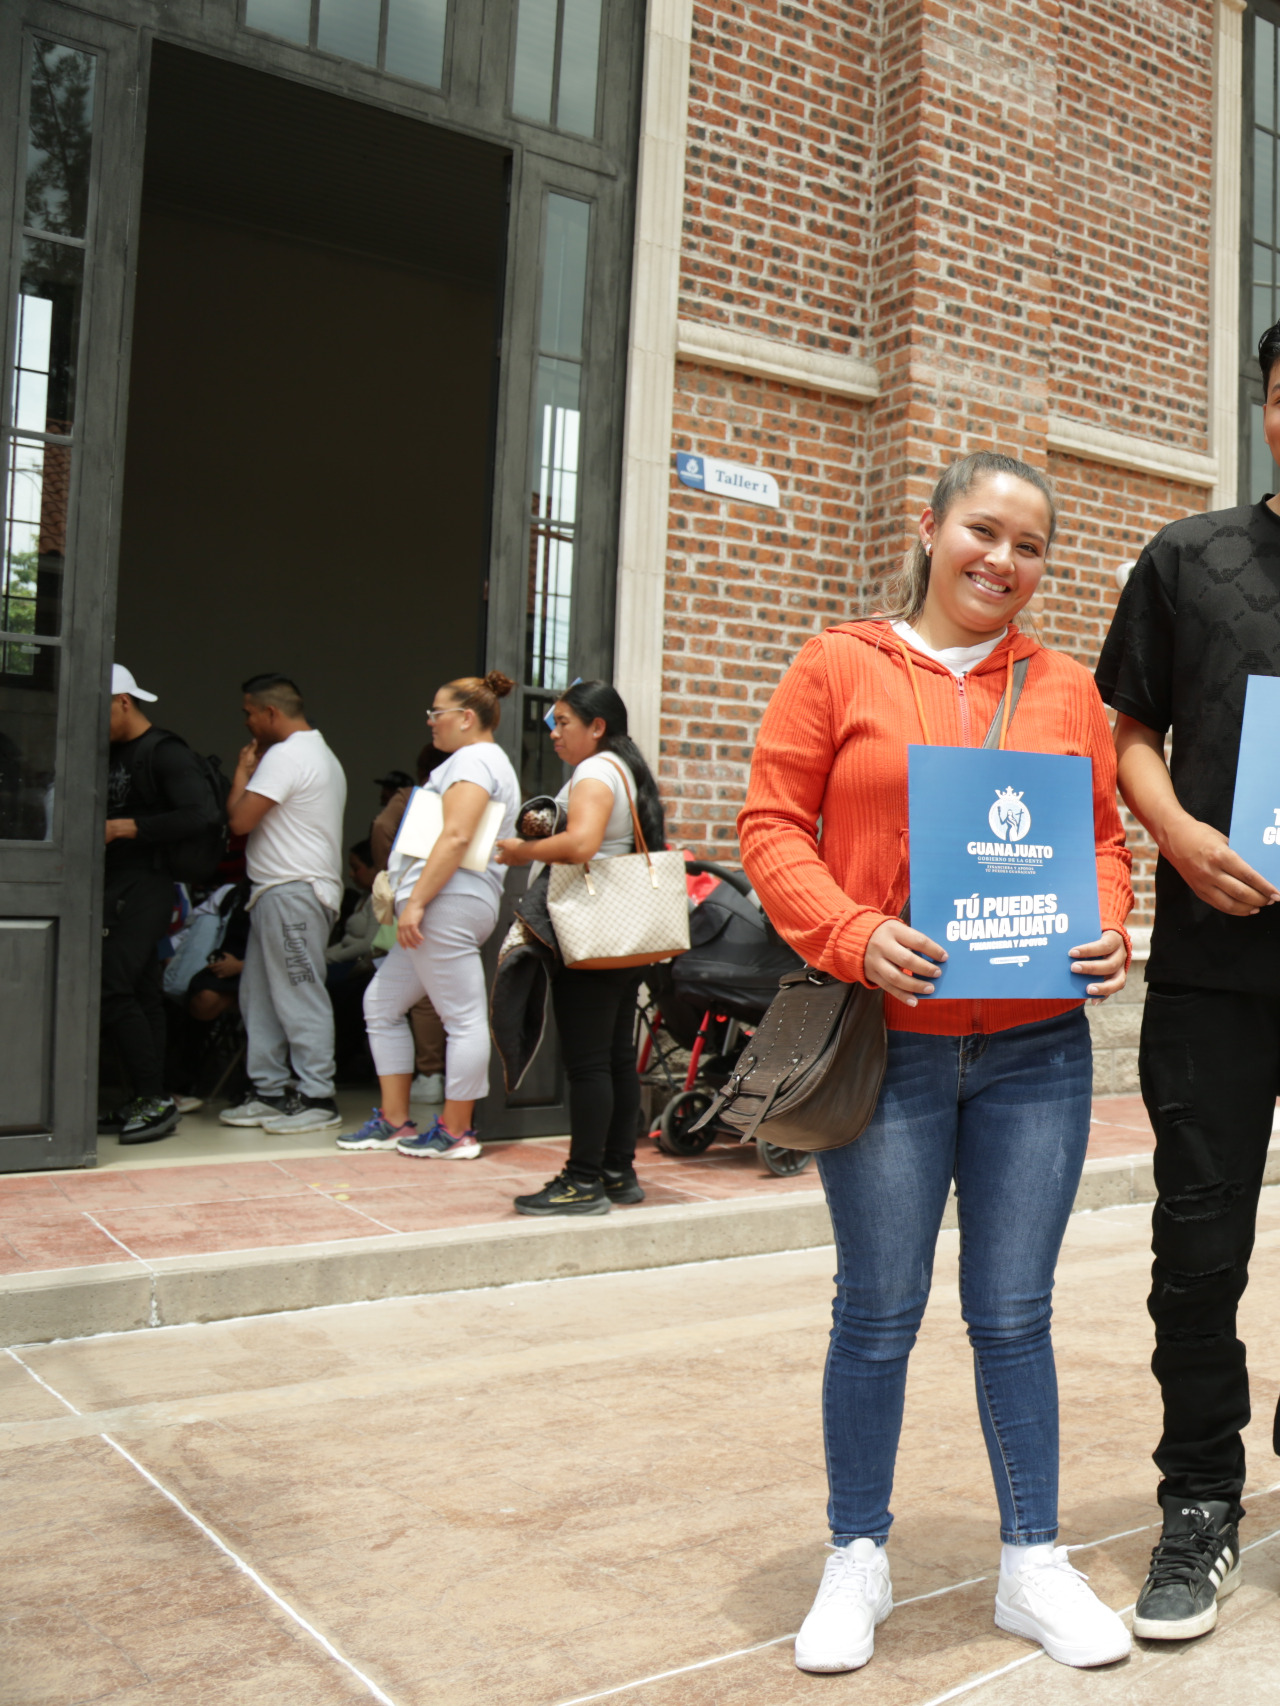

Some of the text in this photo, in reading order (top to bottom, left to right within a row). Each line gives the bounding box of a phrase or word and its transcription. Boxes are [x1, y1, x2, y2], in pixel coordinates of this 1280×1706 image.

[715, 469, 759, 491] Taller
[967, 841, 1053, 859] GUANAJUATO
[954, 893, 1058, 919] TÚ PUEDES
[946, 913, 1069, 942] GUANAJUATO
[282, 922, 315, 986] LOVE
[1012, 940, 1019, 948] Y
